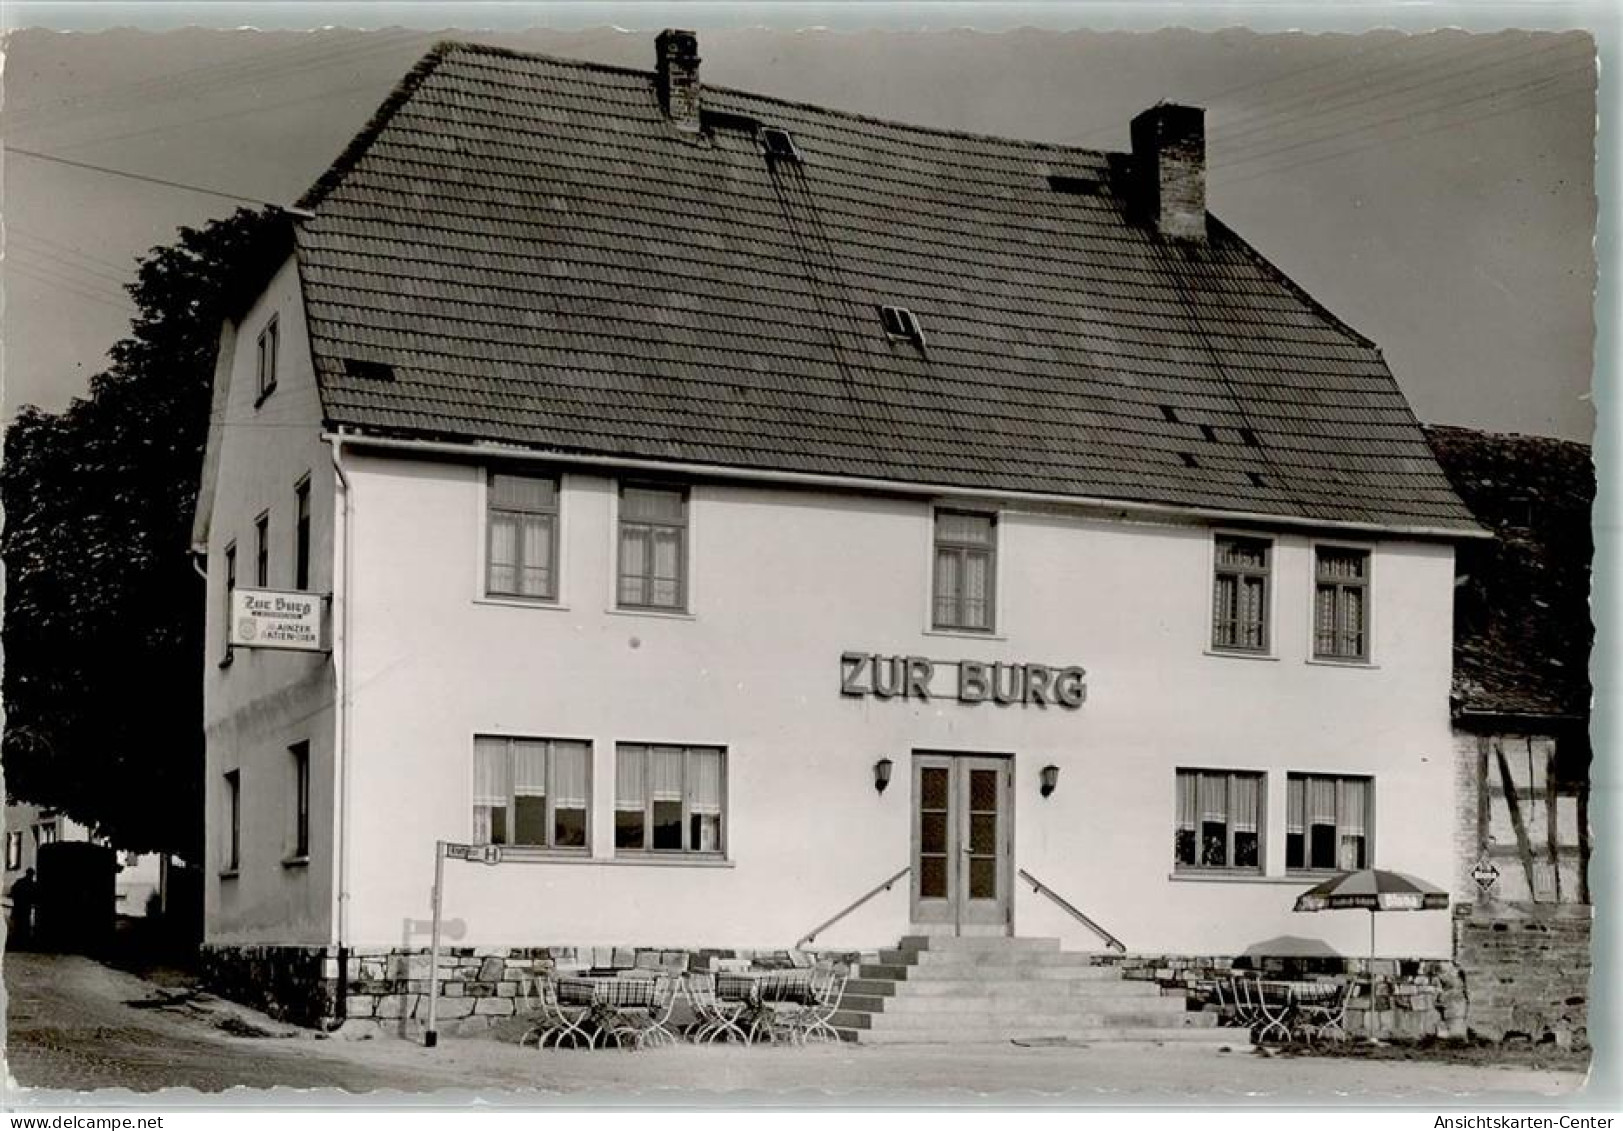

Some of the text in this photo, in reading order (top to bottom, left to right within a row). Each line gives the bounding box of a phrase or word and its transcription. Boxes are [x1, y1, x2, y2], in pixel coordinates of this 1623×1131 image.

[244, 595, 272, 610] Zur
[275, 597, 312, 616] Burg
[840, 651, 1087, 710] ZUR BURG
[484, 847, 497, 860] H
